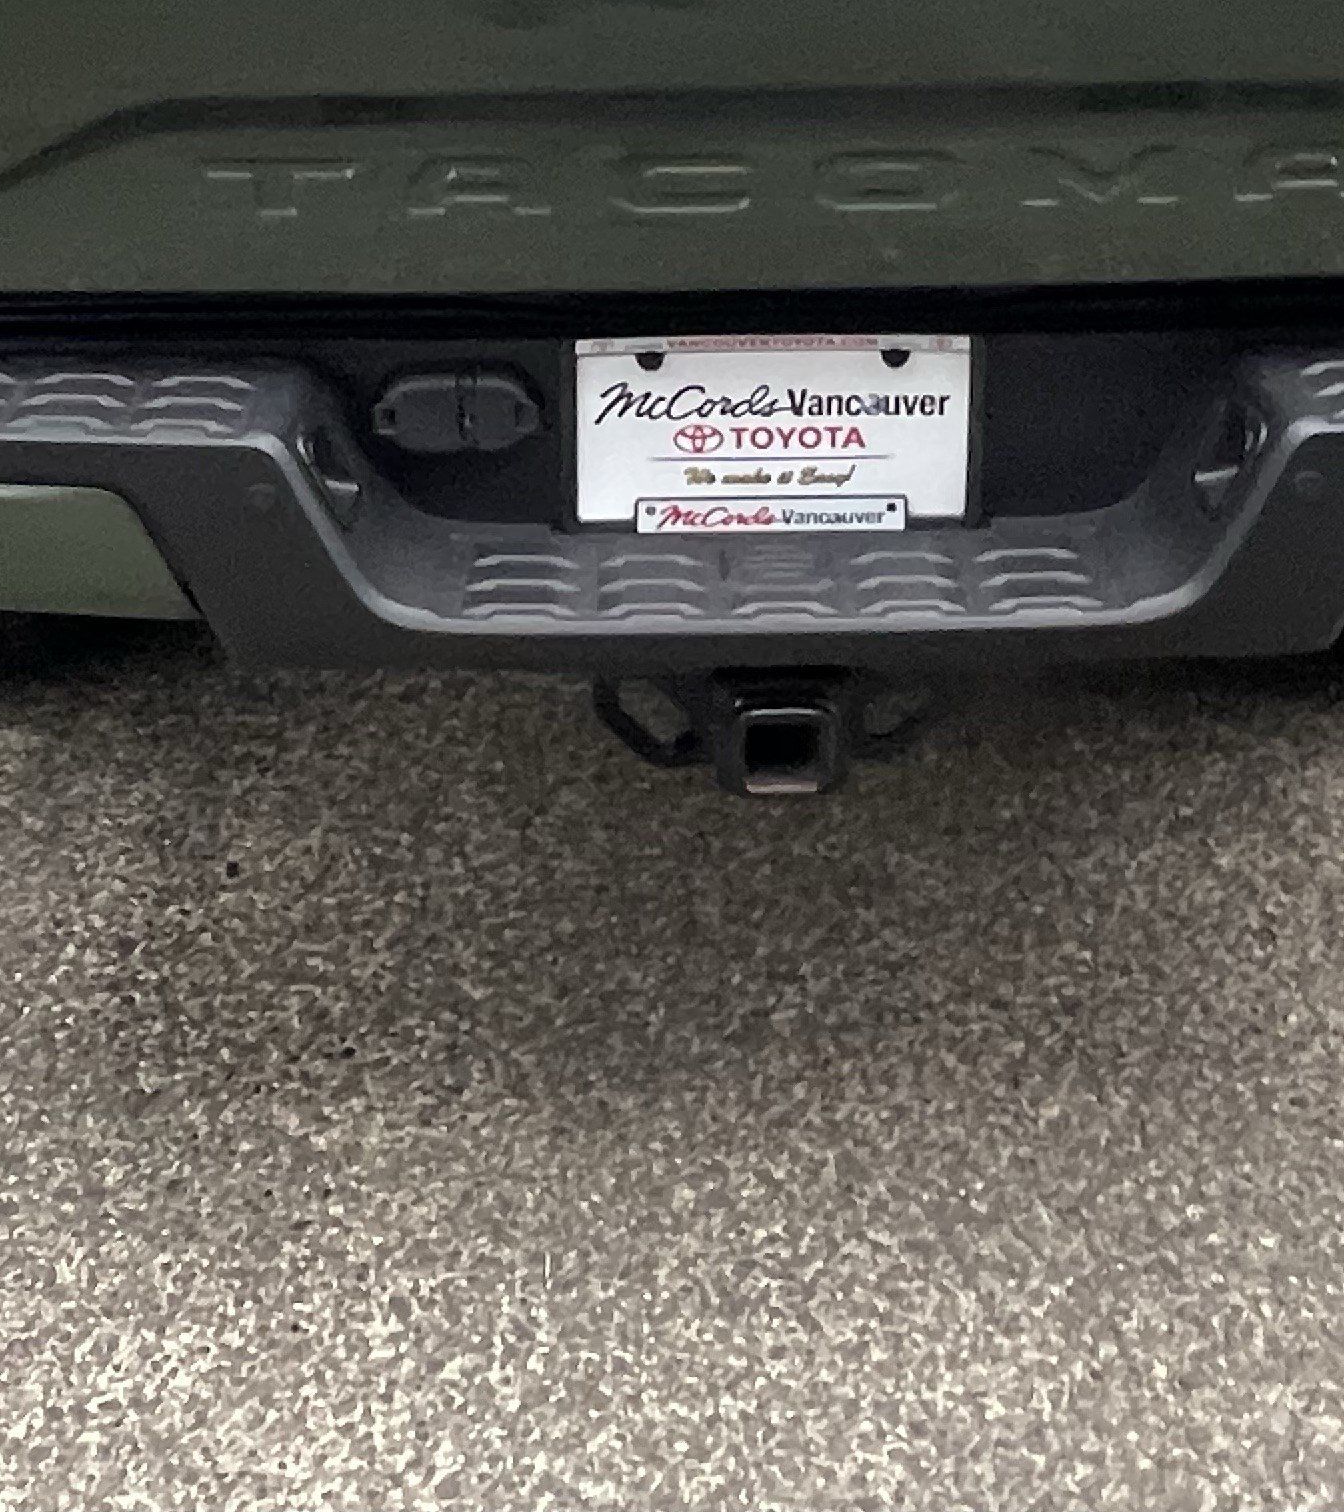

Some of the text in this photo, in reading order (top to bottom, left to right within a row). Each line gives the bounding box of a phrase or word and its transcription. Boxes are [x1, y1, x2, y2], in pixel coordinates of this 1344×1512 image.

[788, 387, 951, 418] Vancouver
[729, 425, 867, 450] TOYOTA
[781, 507, 886, 525] Vancouver
